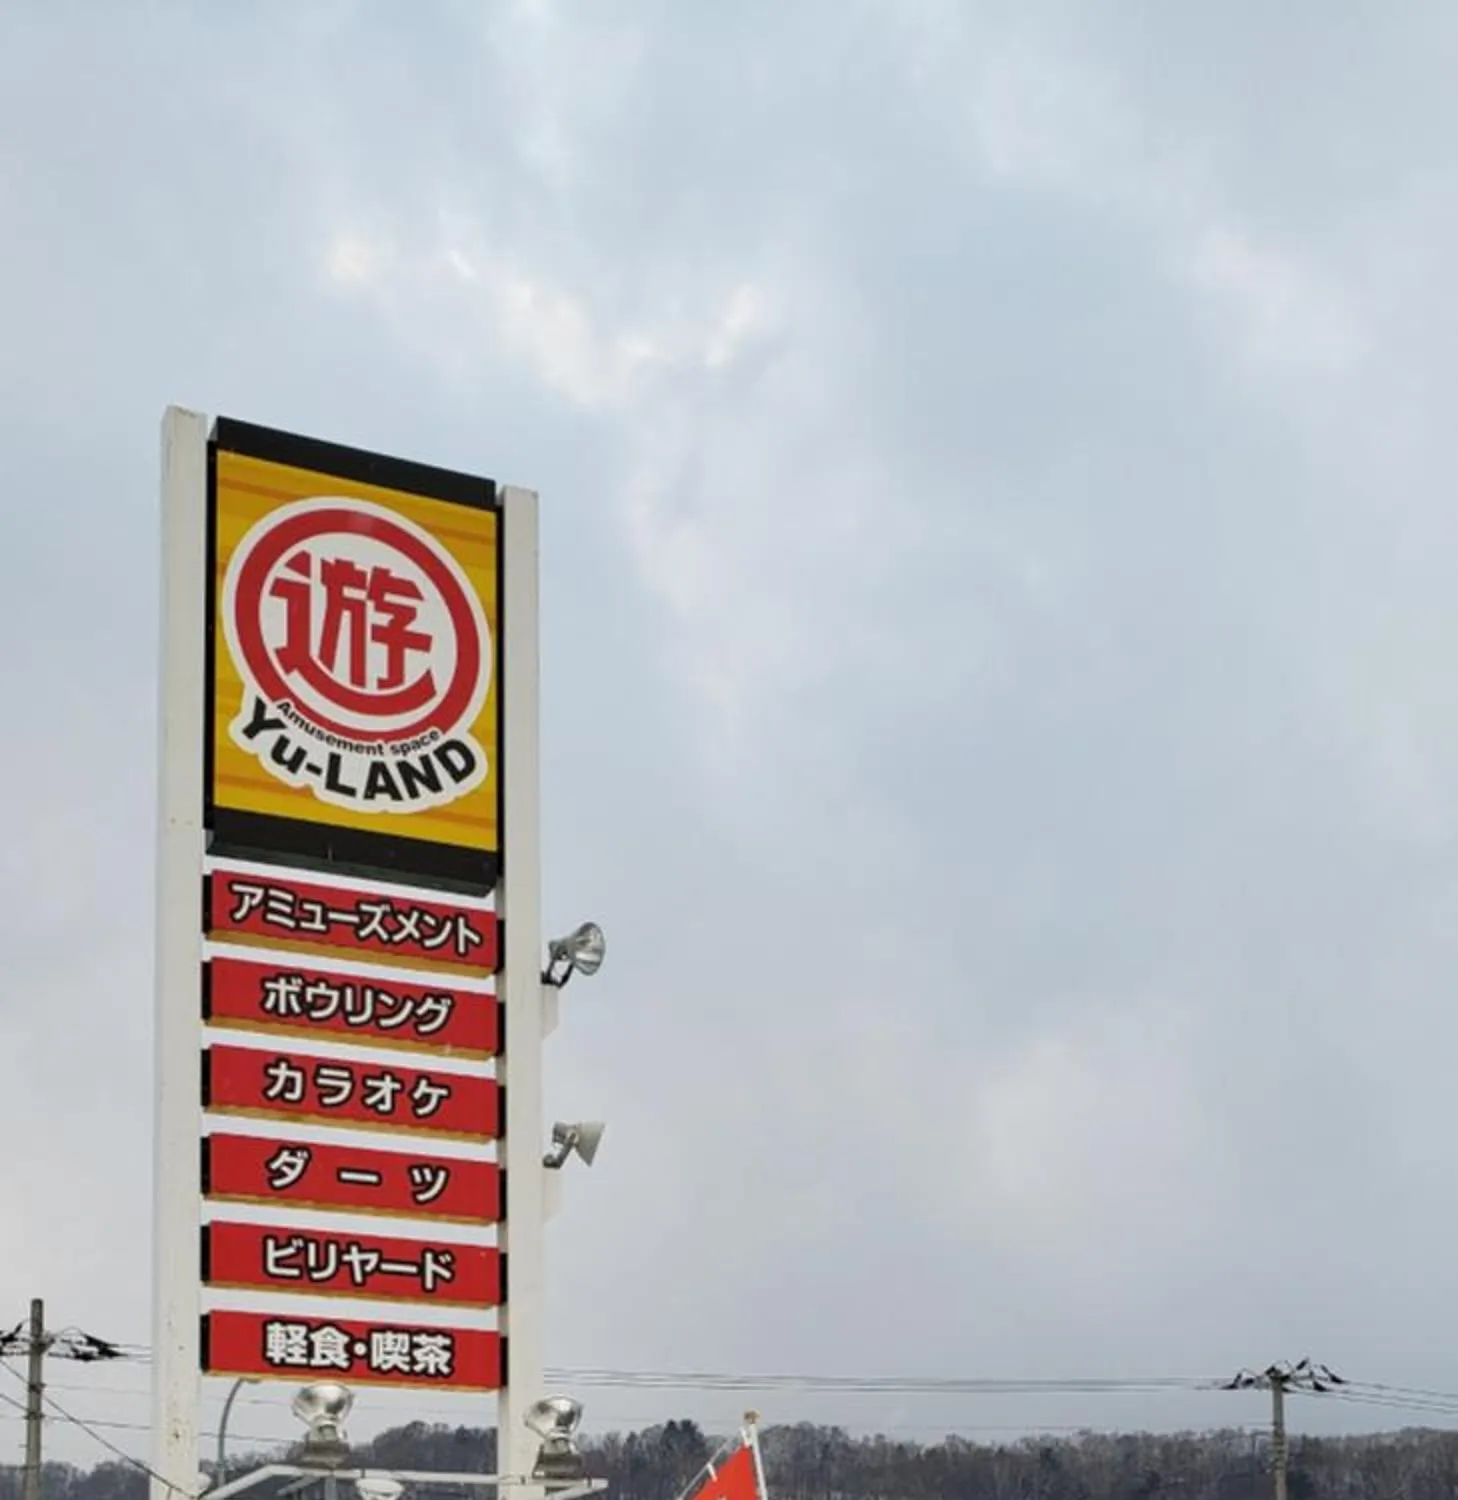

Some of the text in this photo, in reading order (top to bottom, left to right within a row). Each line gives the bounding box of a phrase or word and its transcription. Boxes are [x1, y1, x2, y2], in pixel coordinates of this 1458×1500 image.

[270, 549, 437, 717] 遊
[242, 696, 477, 802] Yu-LAND
[277, 700, 440, 757] Amusement space
[231, 882, 483, 954] アミューズメント
[263, 976, 452, 1033] ボウリング
[264, 1062, 449, 1116] カラオケ
[268, 1149, 448, 1202] ダーツ
[264, 1238, 454, 1290] ビリヤード
[265, 1322, 452, 1376] 軽食・喫茶
